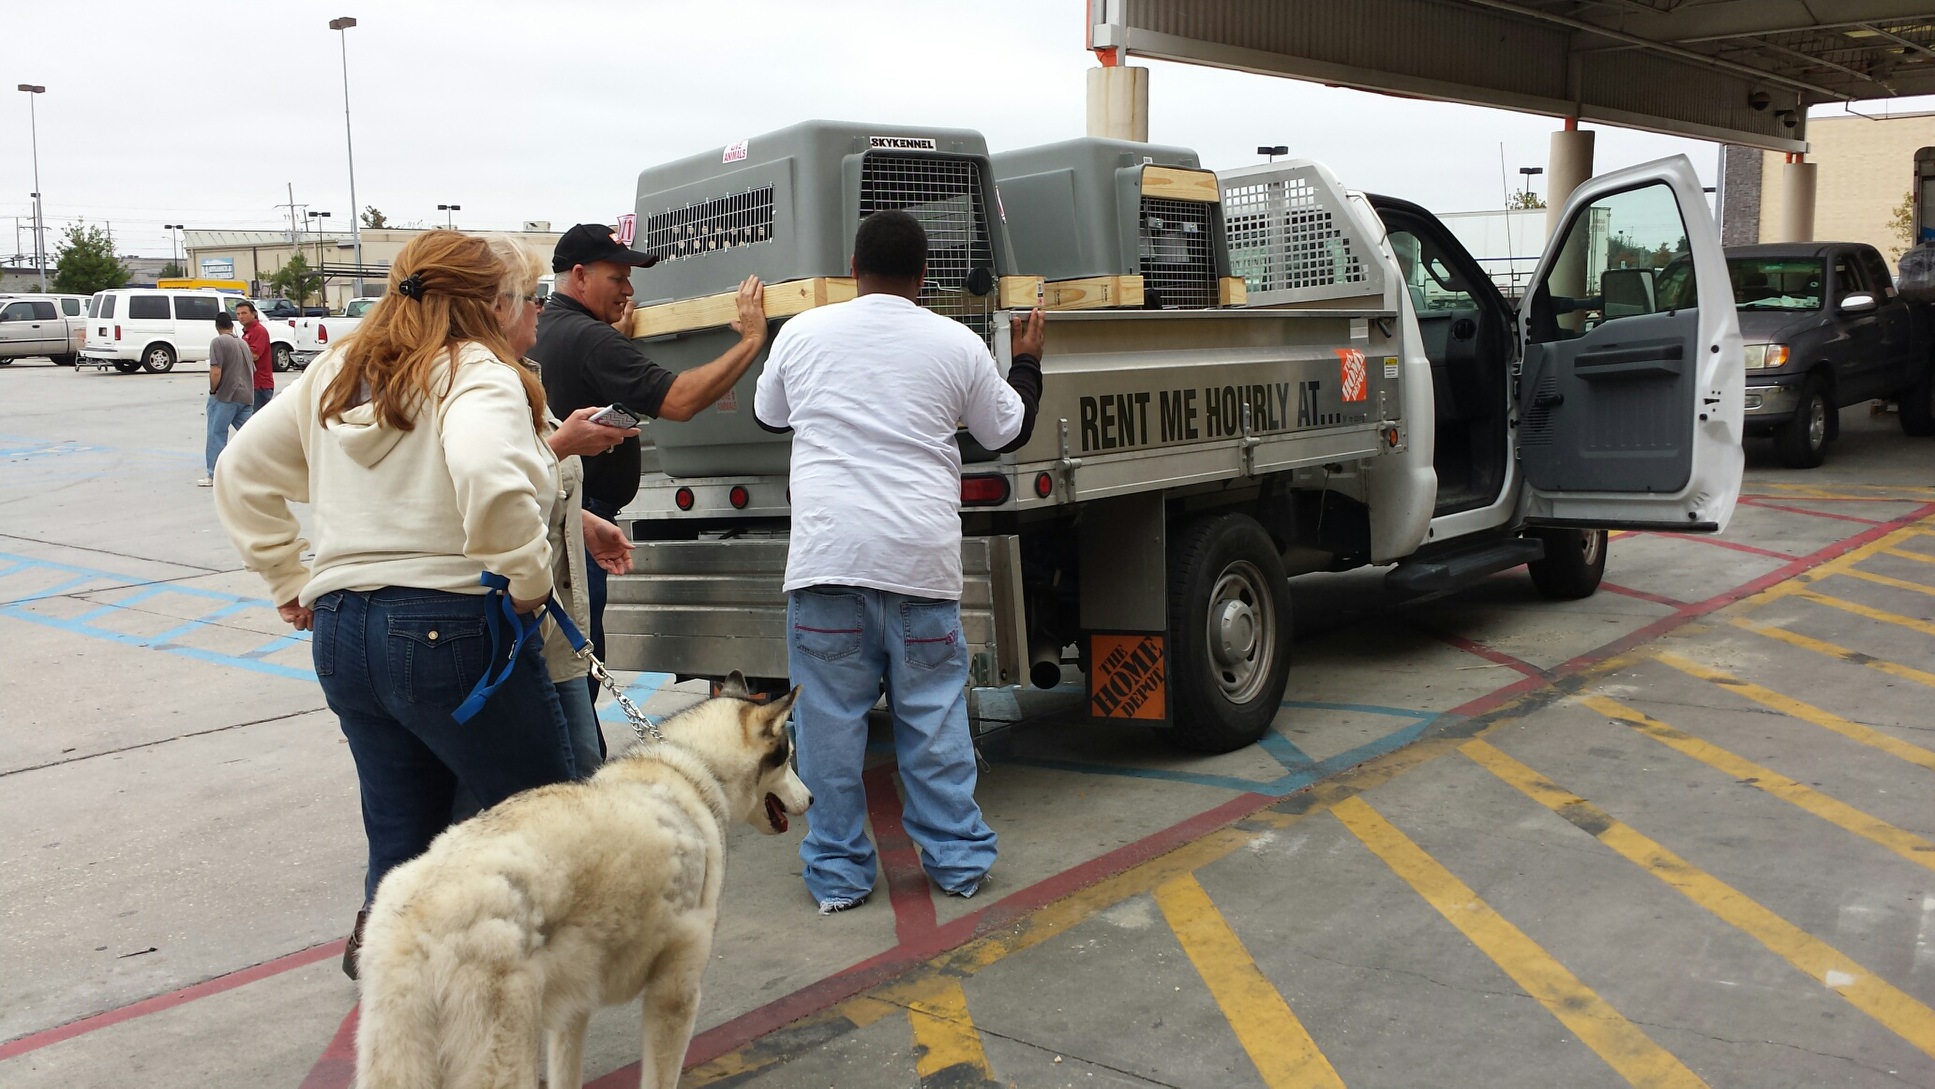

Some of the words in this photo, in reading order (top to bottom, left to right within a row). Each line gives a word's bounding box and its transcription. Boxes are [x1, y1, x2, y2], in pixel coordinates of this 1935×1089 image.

[871, 137, 934, 149] SKYKENNEL
[1342, 348, 1366, 401] HOME
[1351, 366, 1366, 401] DEPOT
[1079, 391, 1151, 452] RENT
[1159, 388, 1199, 443] ME
[1205, 382, 1289, 438] HOURLY
[1092, 636, 1164, 717] HOME
[1098, 643, 1129, 676] THE
[1120, 667, 1164, 719] DEPOT
